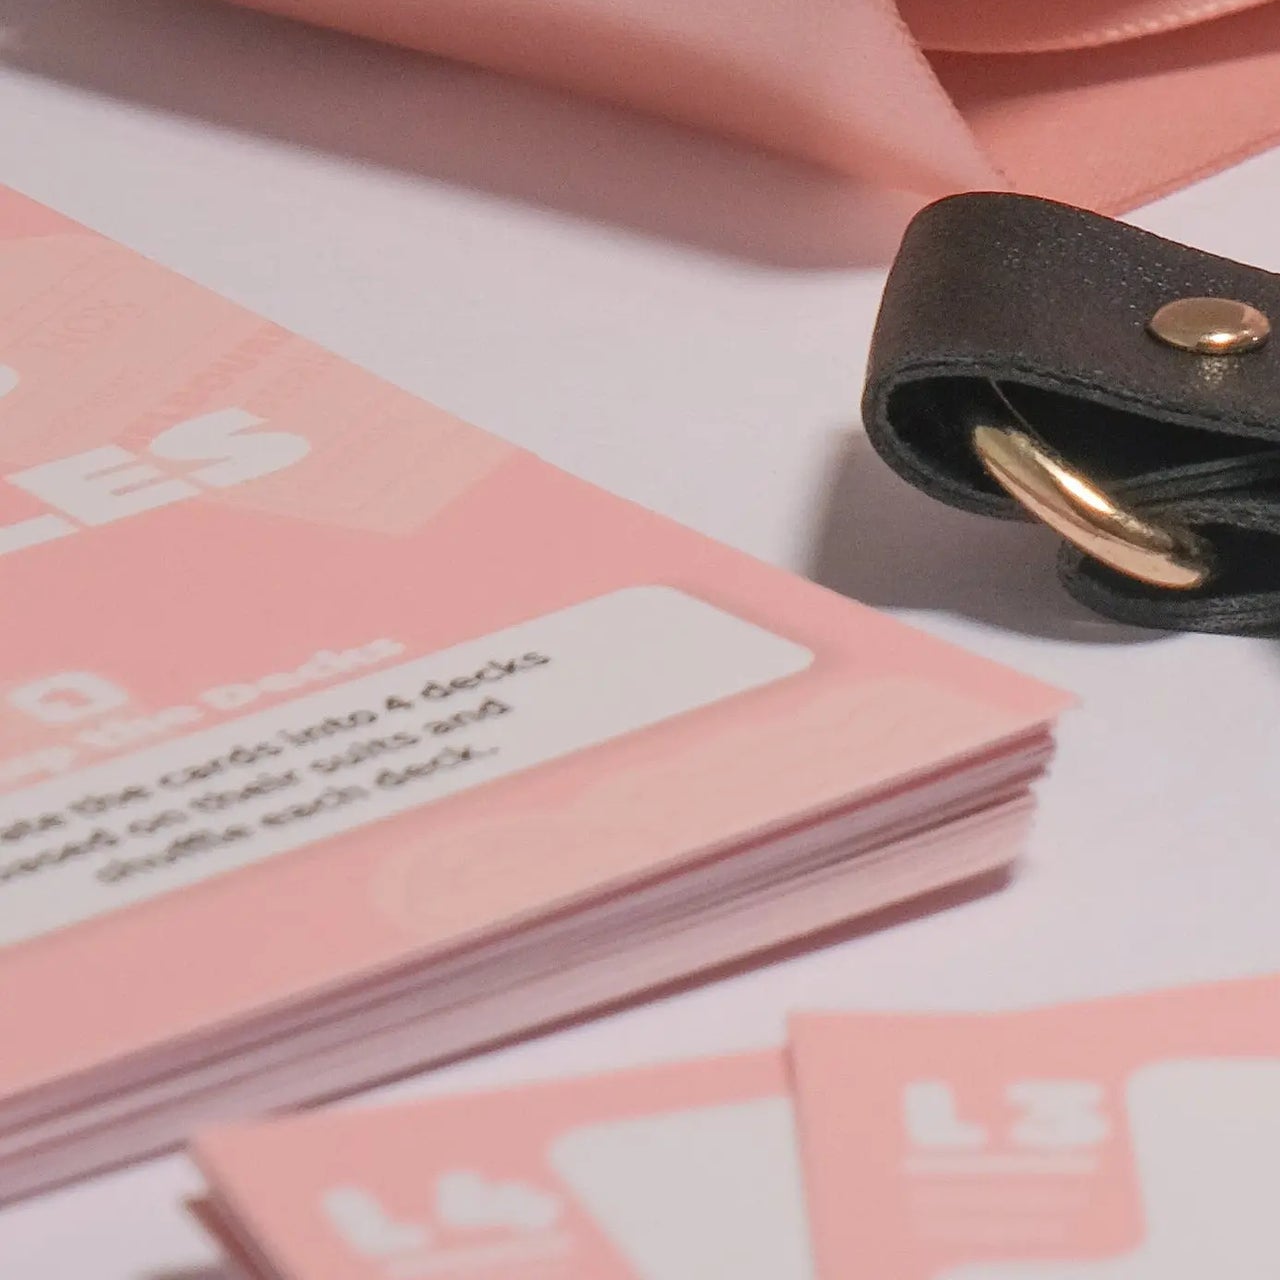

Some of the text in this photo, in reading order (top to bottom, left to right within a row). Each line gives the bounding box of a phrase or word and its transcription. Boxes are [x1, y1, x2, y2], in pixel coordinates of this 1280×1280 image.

[68, 784, 152, 818] the
[158, 741, 284, 788] cards
[278, 708, 378, 748] into
[384, 694, 415, 712] 4
[420, 649, 552, 702] decks
[78, 704, 204, 748] the
[199, 638, 406, 710] Decks
[96, 744, 501, 884] shuffle each deck.
[127, 808, 188, 835] on
[188, 770, 300, 812] their
[309, 730, 421, 775] suits
[423, 695, 513, 737] and
